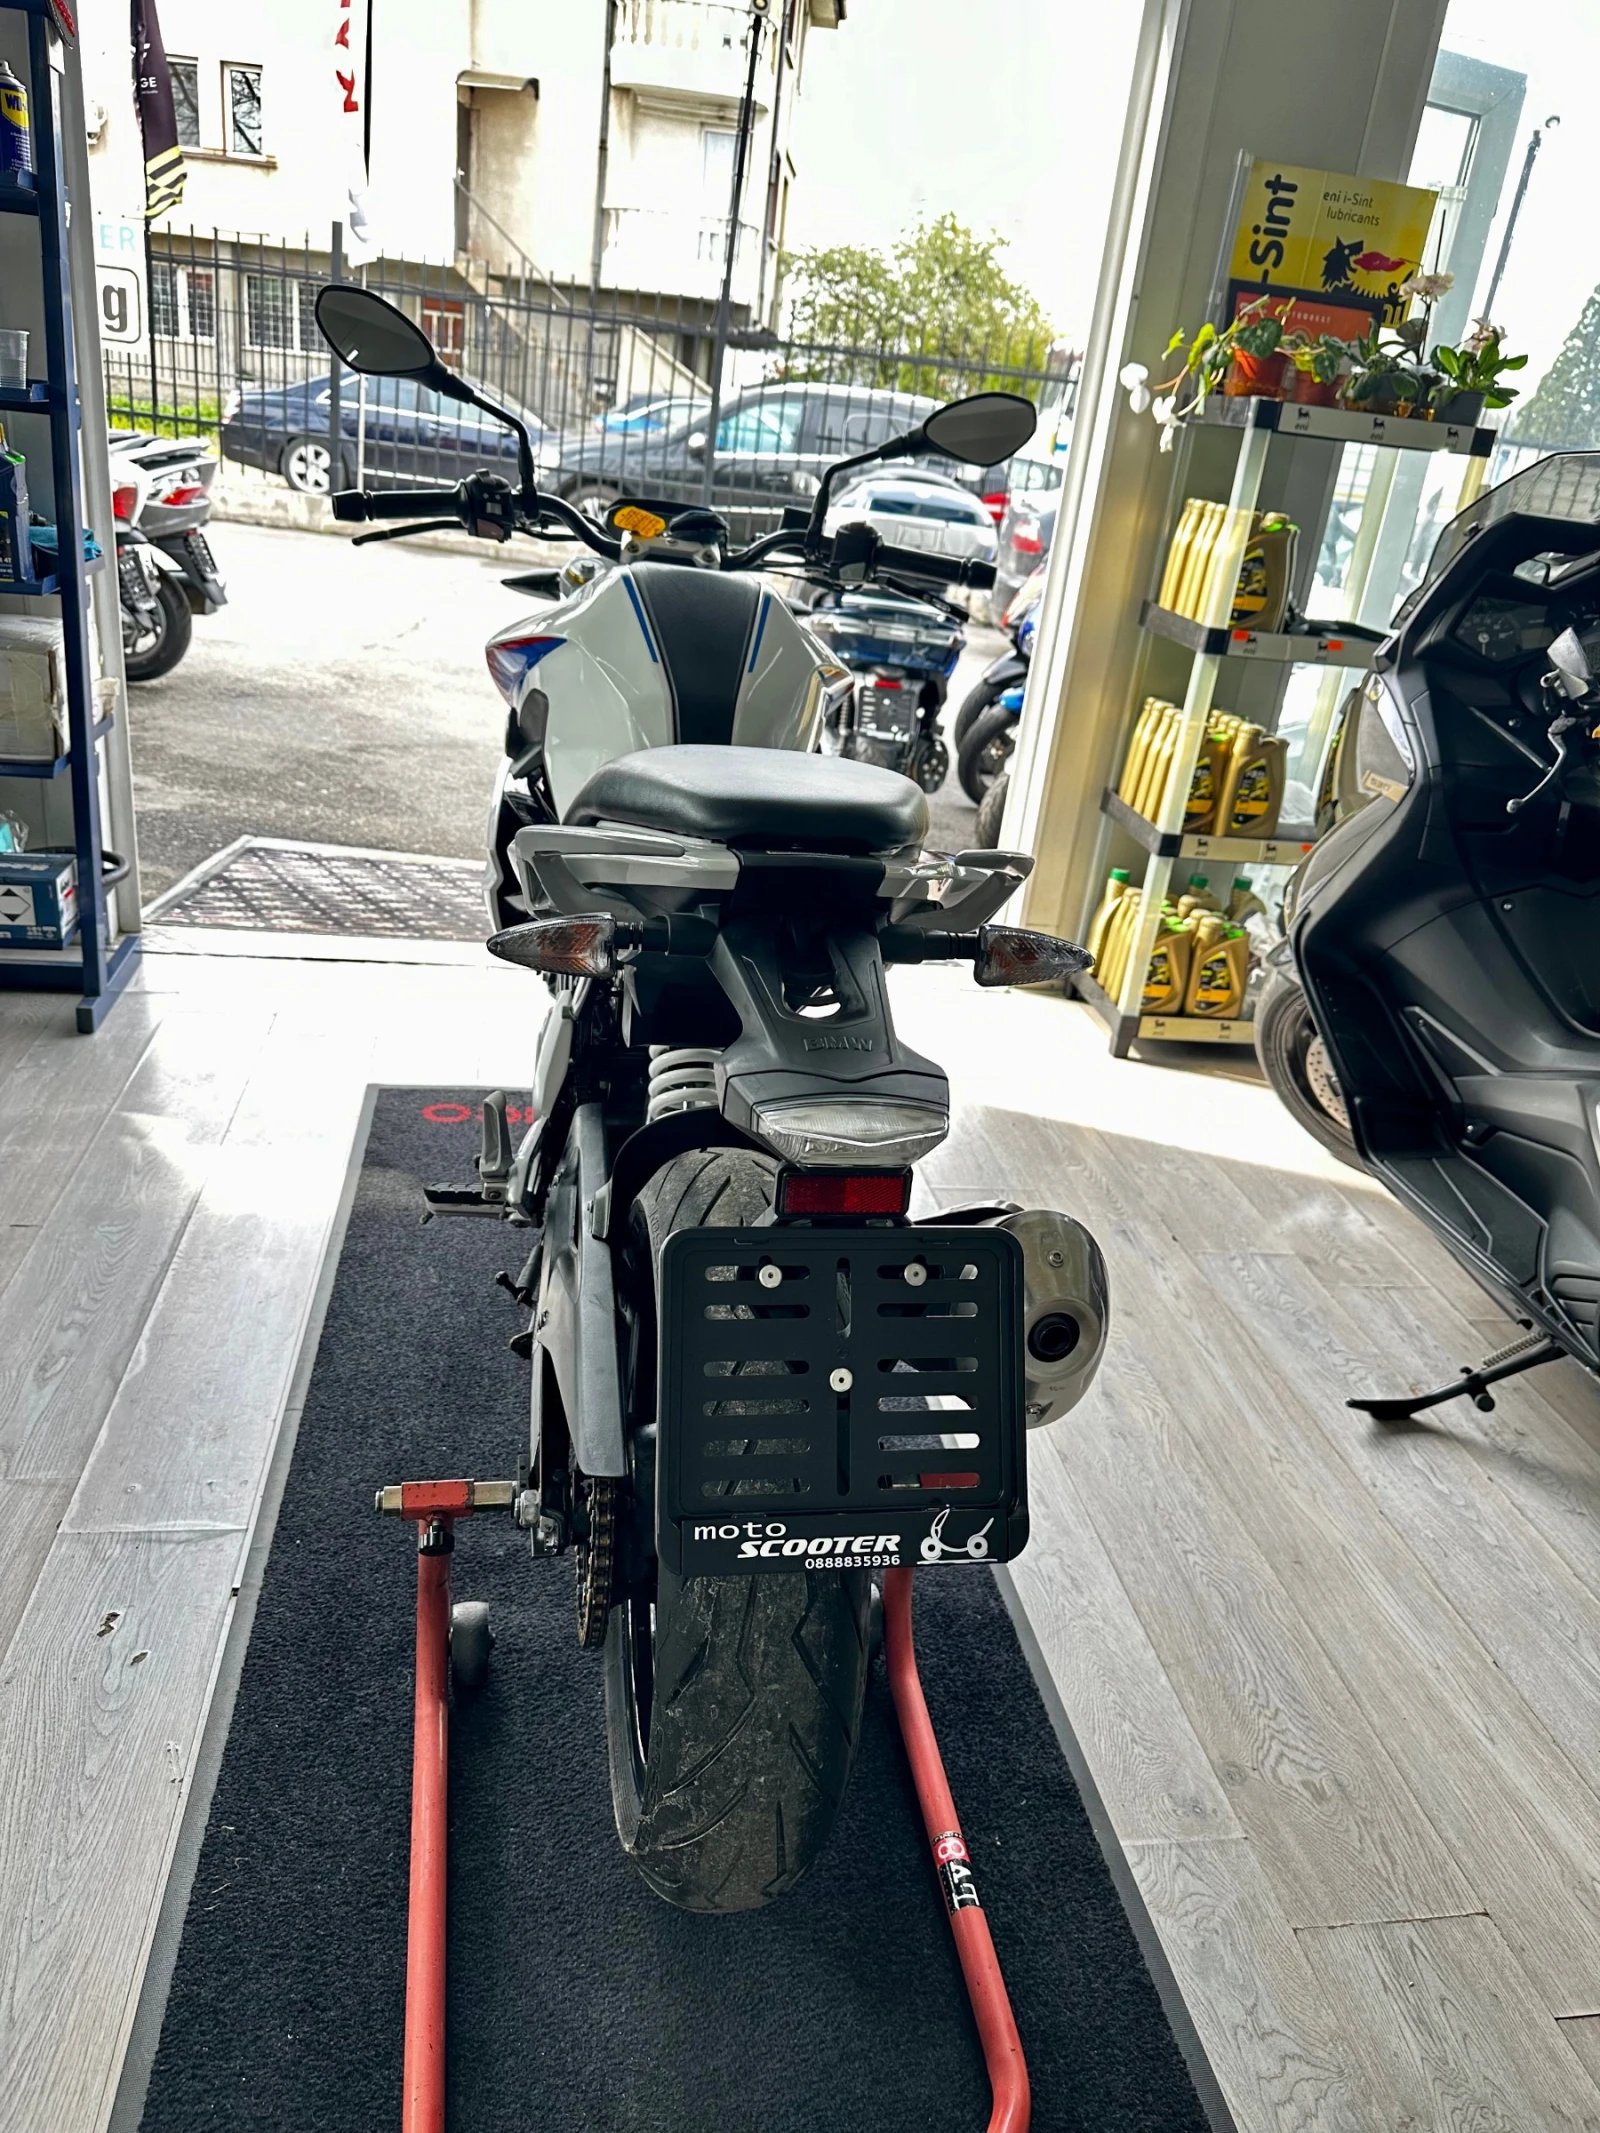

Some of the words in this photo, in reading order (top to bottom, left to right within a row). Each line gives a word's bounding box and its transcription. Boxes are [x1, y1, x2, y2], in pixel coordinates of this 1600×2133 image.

[1323, 190, 1340, 203] eni
[1342, 191, 1374, 208] i-Sint
[1326, 206, 1380, 226] lubricants
[803, 1036, 873, 1052] BMW
[694, 1522, 787, 1541] moto
[737, 1534, 902, 1559] SCOOTER
[805, 1554, 901, 1570] 0888835936
